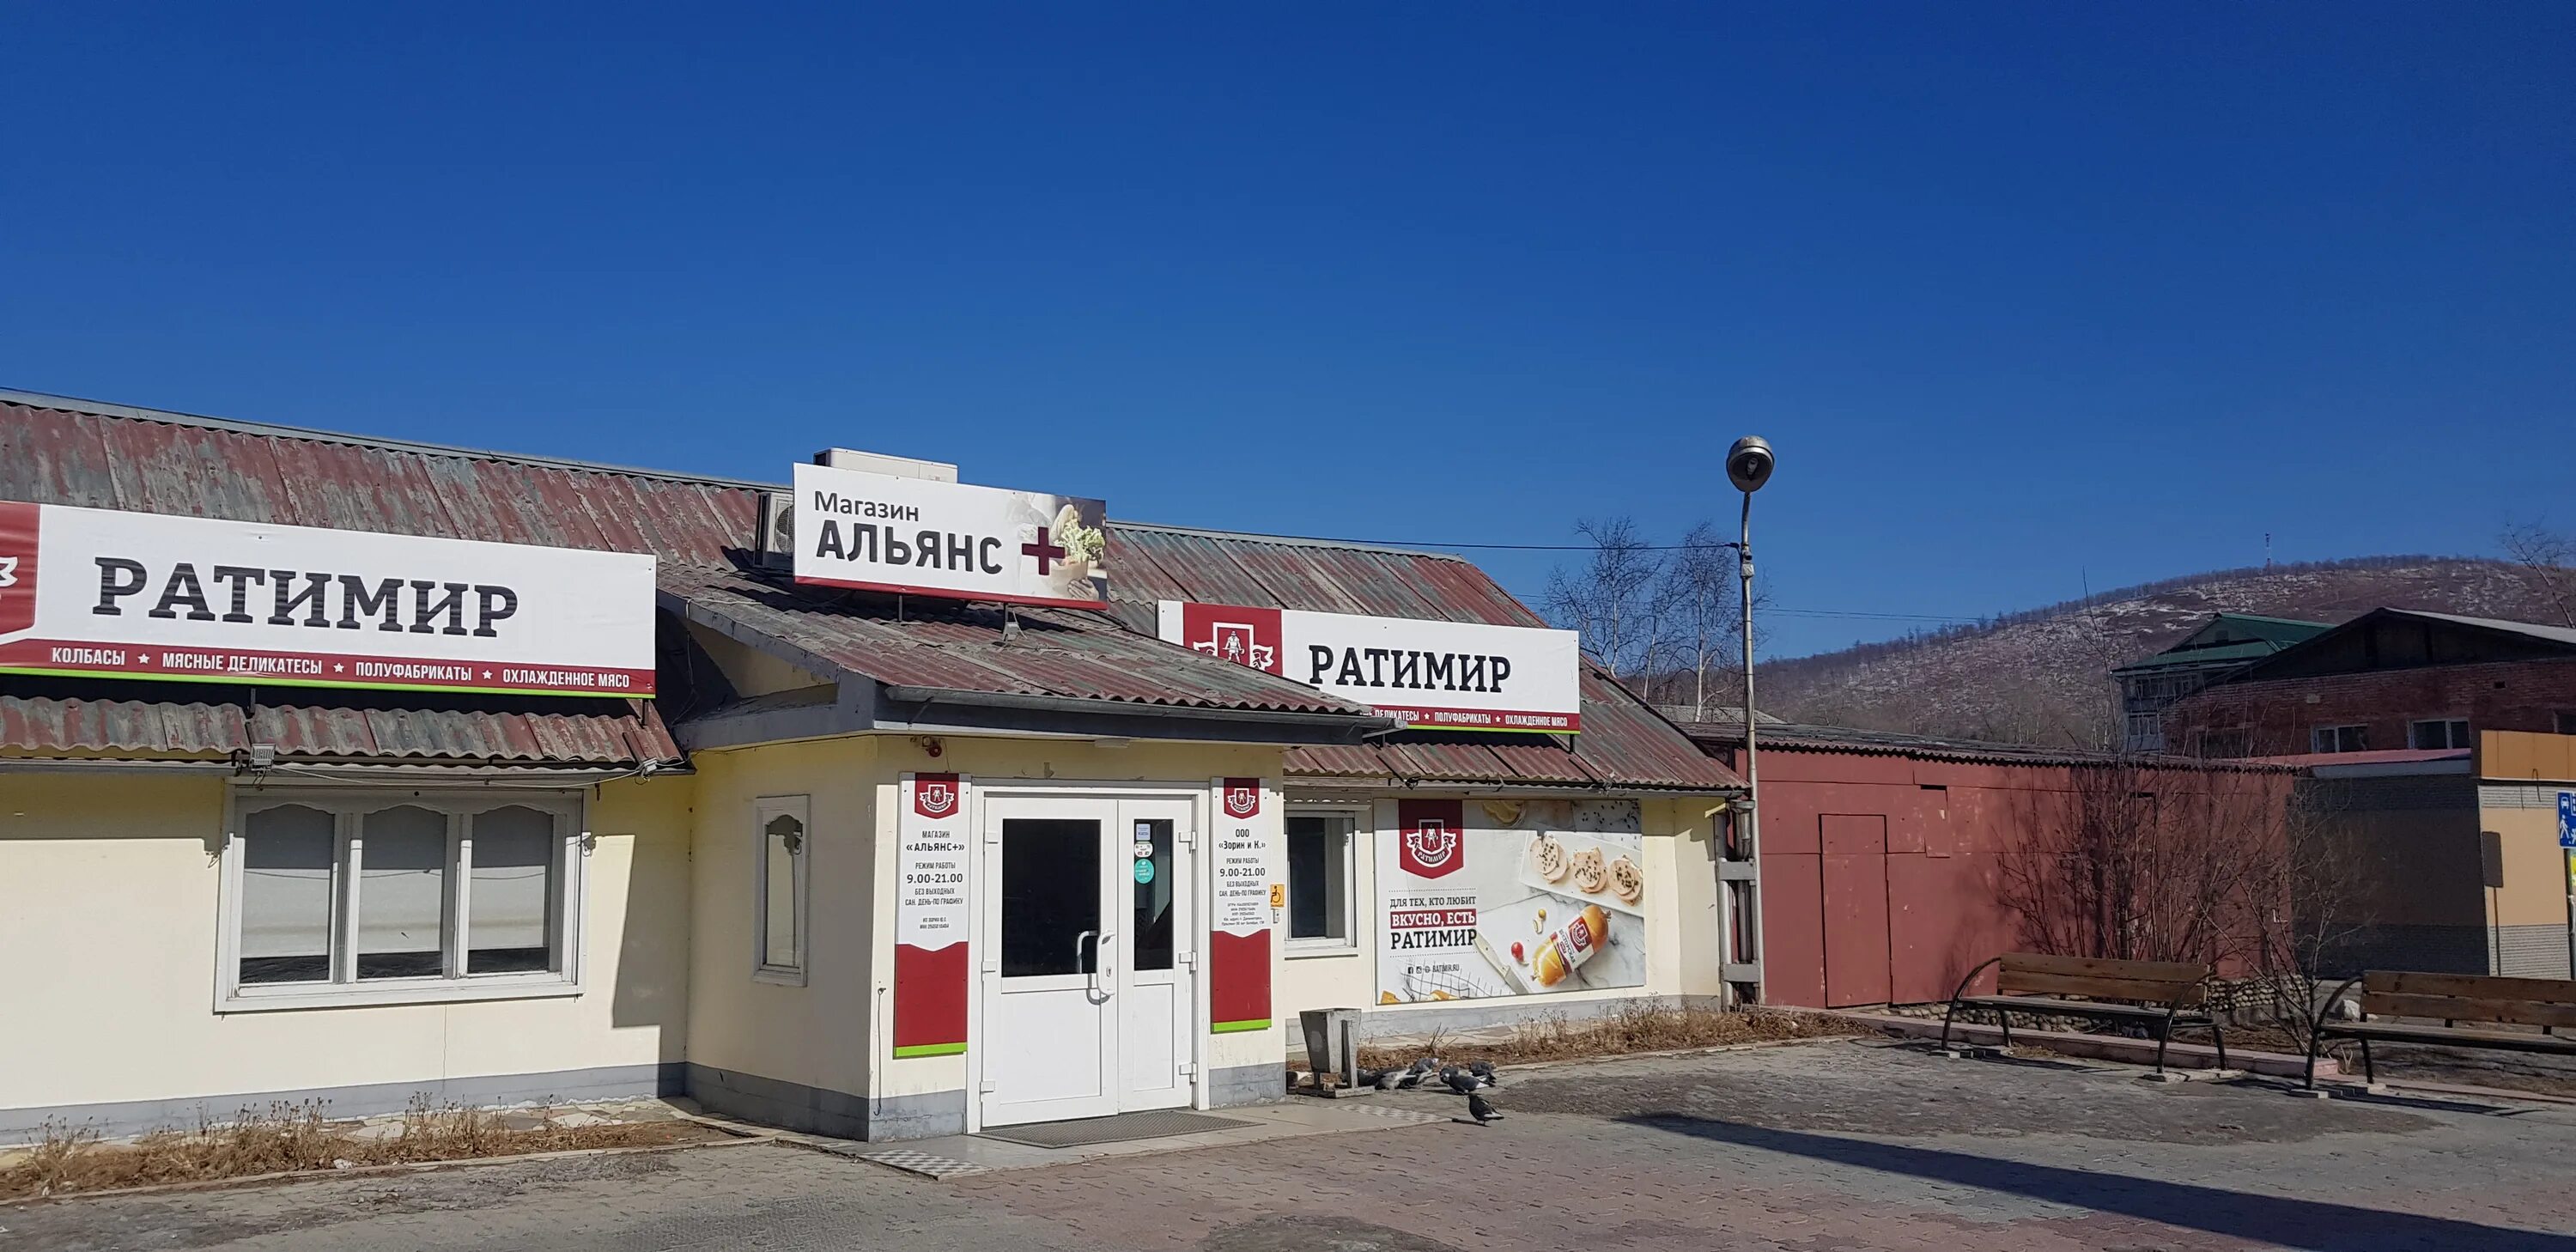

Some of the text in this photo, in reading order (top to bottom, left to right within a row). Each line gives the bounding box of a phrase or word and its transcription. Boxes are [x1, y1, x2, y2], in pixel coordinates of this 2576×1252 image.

[814, 490, 919, 522] Магазин
[816, 519, 1003, 574] АЛЬЯНС
[92, 556, 519, 638] РАТИМИР
[52, 647, 629, 688] КОЛБАСЫ МЯСНЫЕ ДЕЛИКАТЕСЫ ПОЛУФАБРИКАТЫ ОХЛАЖДЕННОЕ МЯСО
[1309, 644, 1511, 694] РАТИМИР
[1434, 711, 1492, 724] ПОЛУФАБРИКАТЫ
[1505, 714, 1551, 726] ОХЛАЖДЕННОЕ
[1552, 716, 1568, 726] МЯСО
[1235, 829, 1249, 837] ООО
[906, 842, 965, 852] «АЛЬЯНС+»
[1218, 841, 1245, 851] «Зорин
[907, 873, 963, 884] 9.00-21.00
[1219, 867, 1266, 877] 9.00-21.00
[1390, 896, 1477, 909] ДЛЯ ТЕХ, КТО ЛЮБИТ
[1392, 911, 1475, 927] ВКУСНО, ЕСТЬ
[1391, 928, 1477, 950] РАТИМИР
